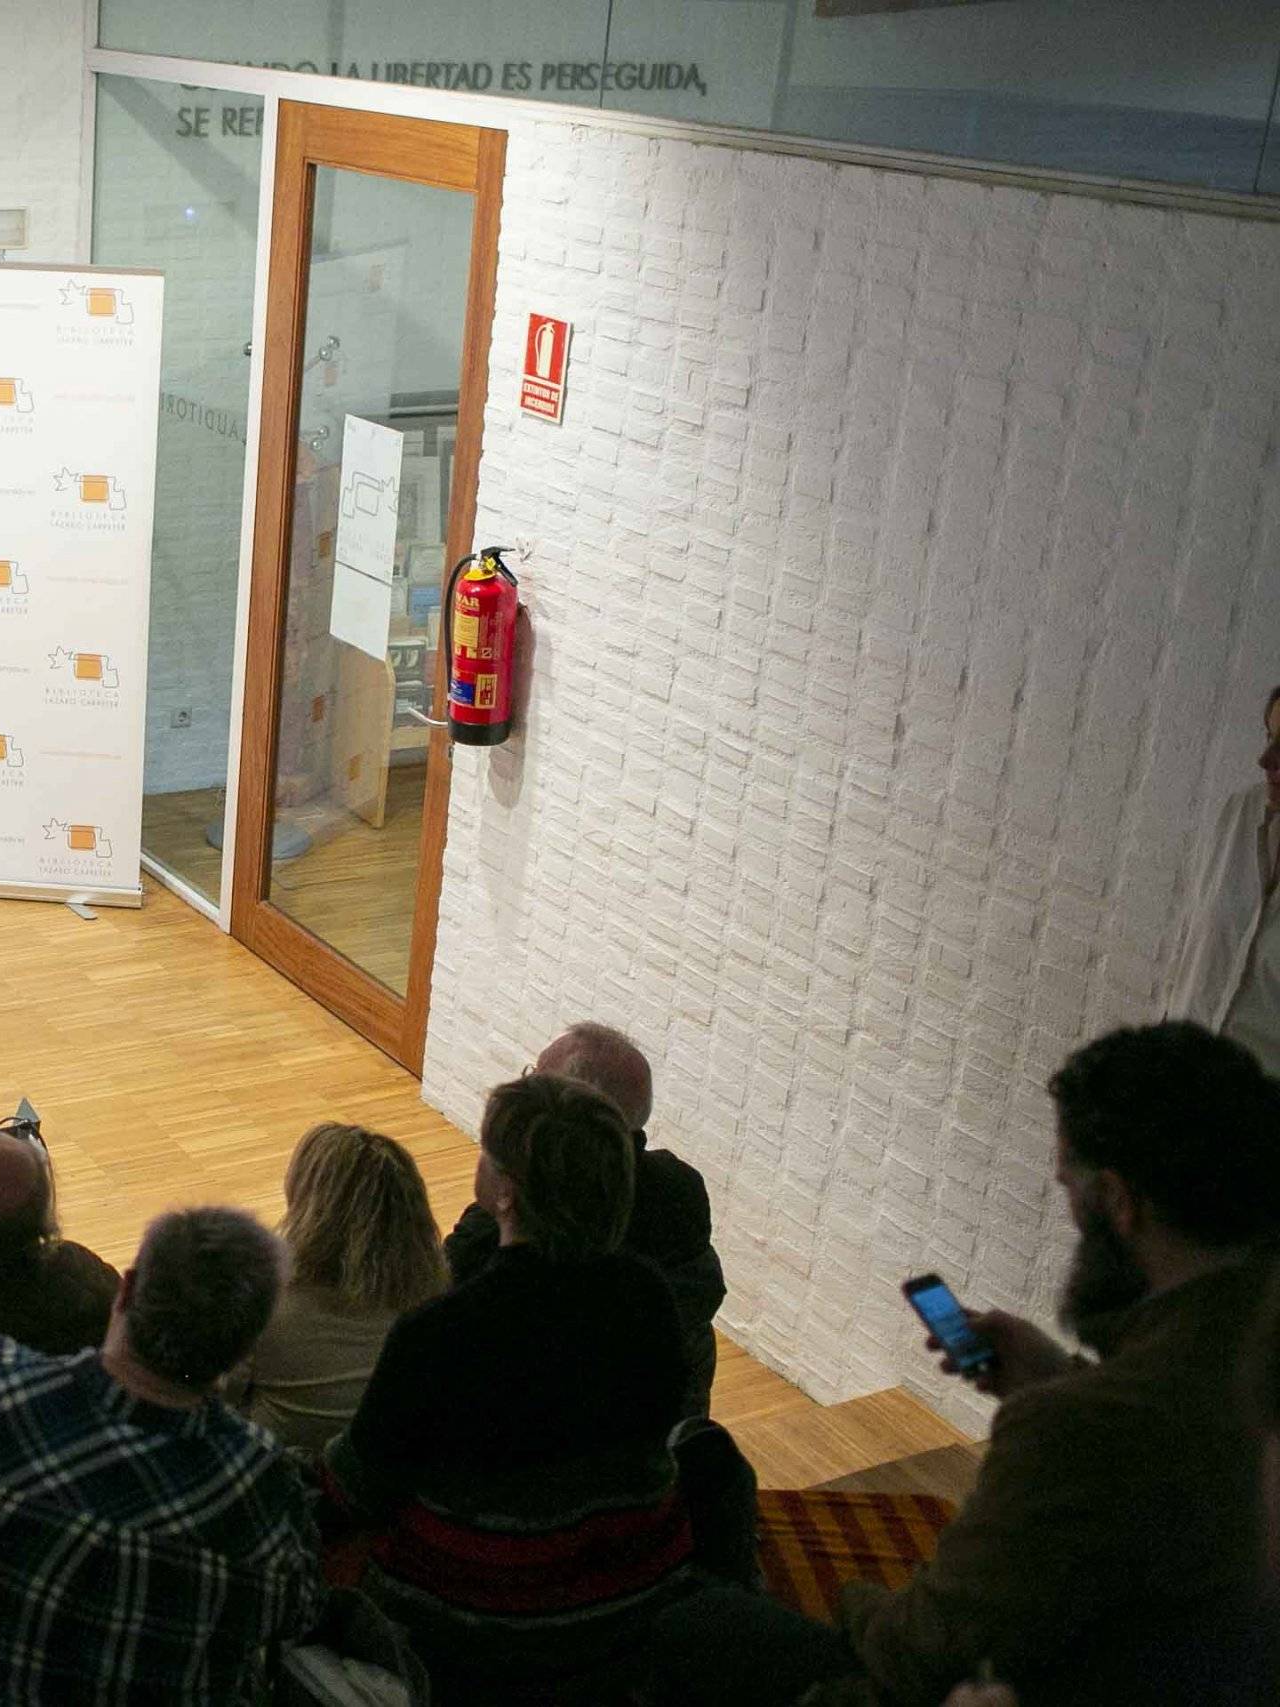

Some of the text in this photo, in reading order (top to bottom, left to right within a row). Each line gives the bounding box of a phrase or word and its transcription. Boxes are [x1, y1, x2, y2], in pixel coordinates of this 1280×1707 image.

[373, 62, 493, 91] LIBERTAD
[502, 62, 532, 91] ES
[540, 62, 707, 97] PERSEGUIDA,
[176, 106, 210, 138] SE
